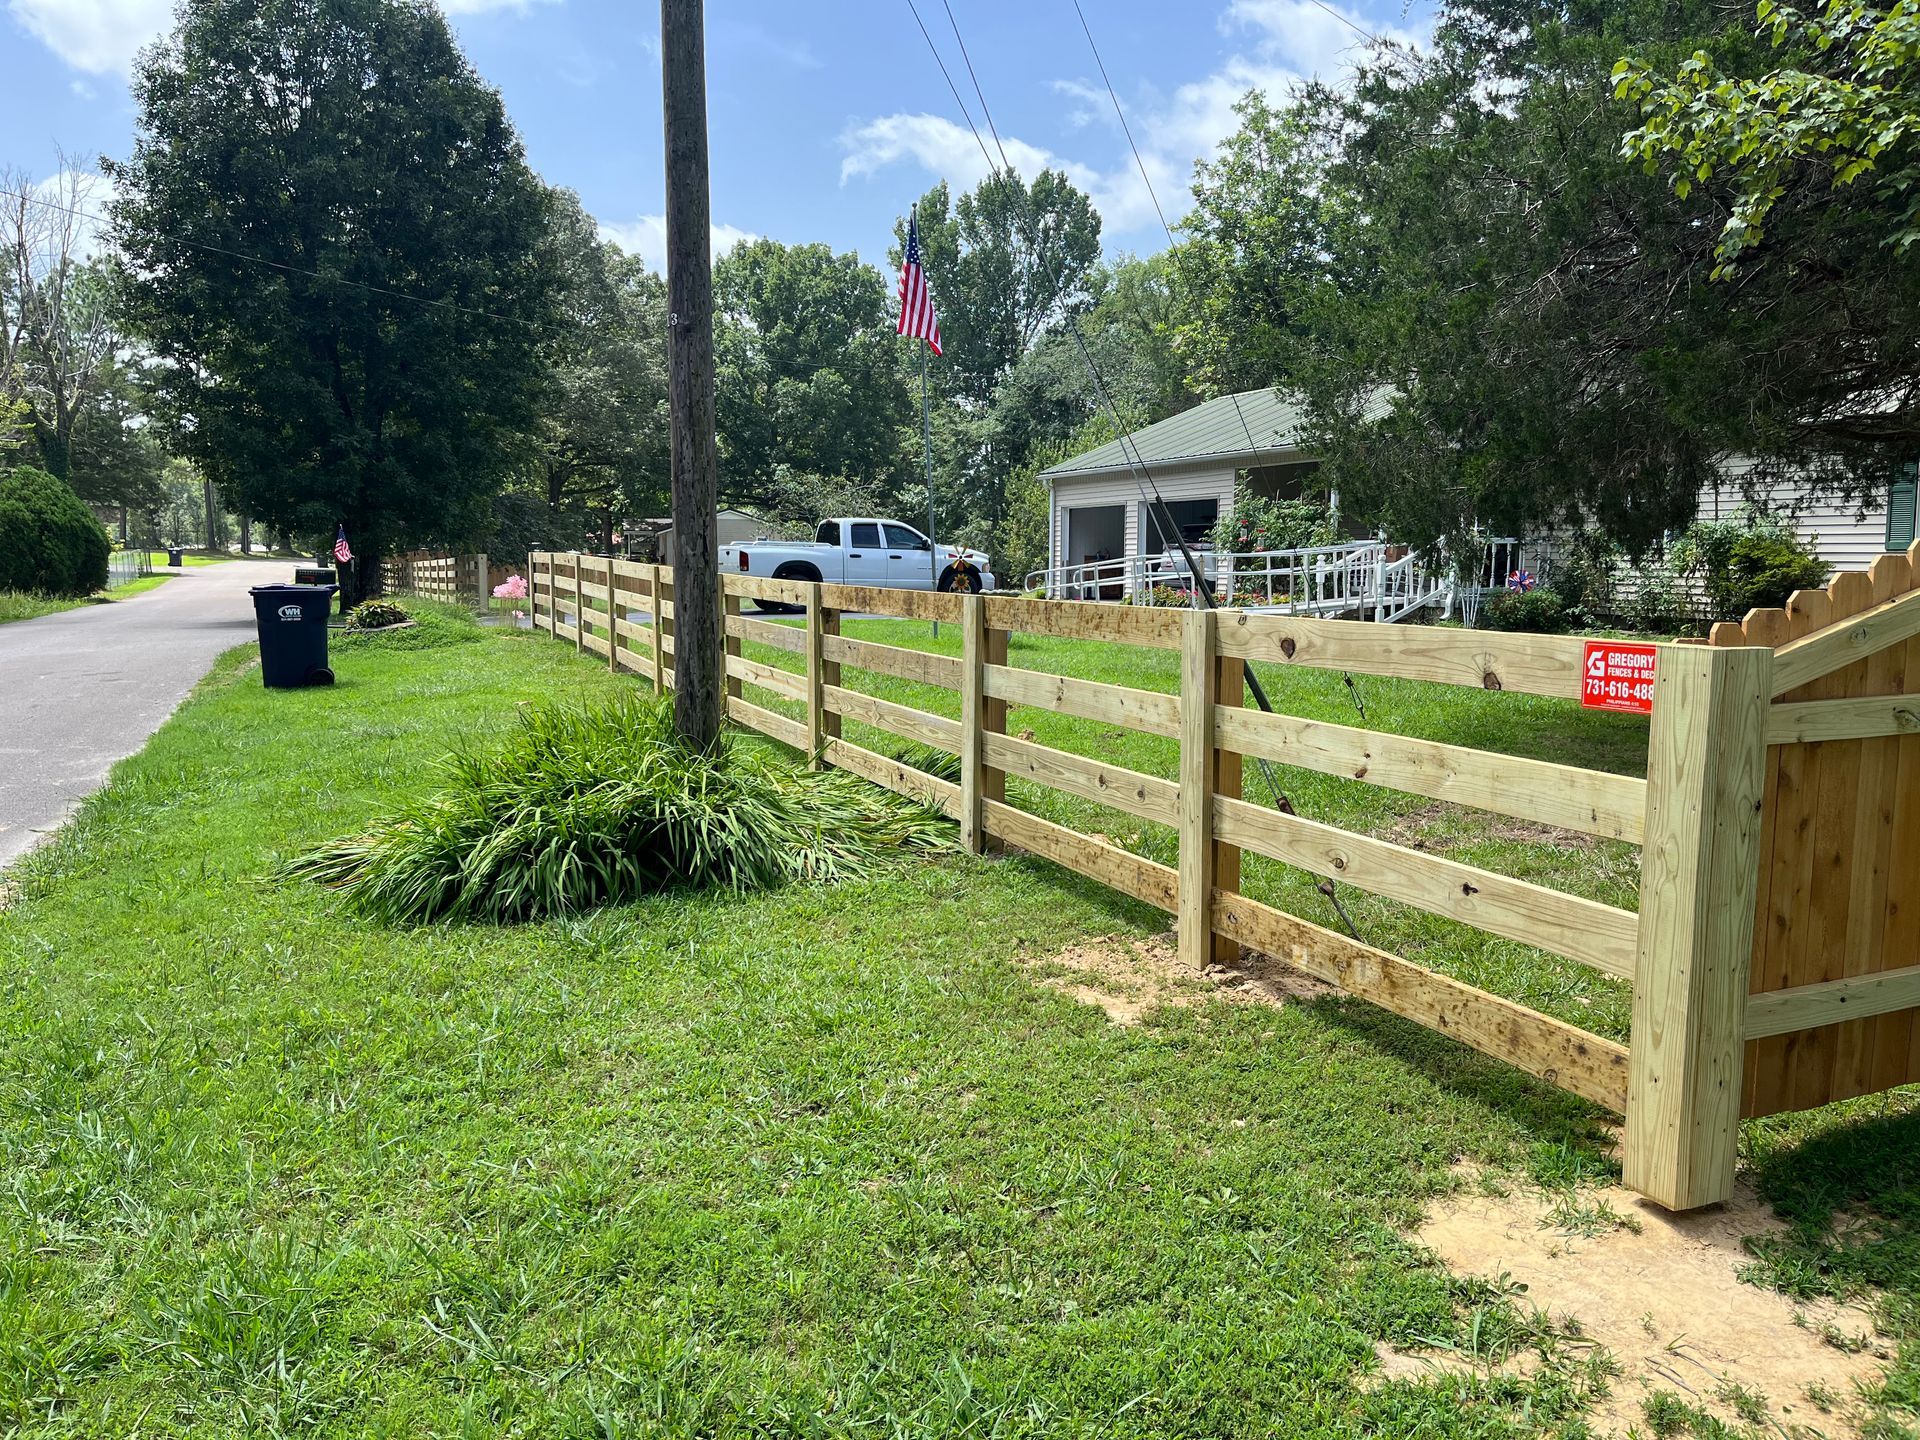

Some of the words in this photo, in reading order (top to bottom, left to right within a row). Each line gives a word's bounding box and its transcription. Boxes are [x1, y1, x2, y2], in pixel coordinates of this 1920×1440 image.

[1608, 653, 1655, 668] GREGORY
[1608, 668, 1632, 678] FENCES
[1633, 669, 1640, 678] &
